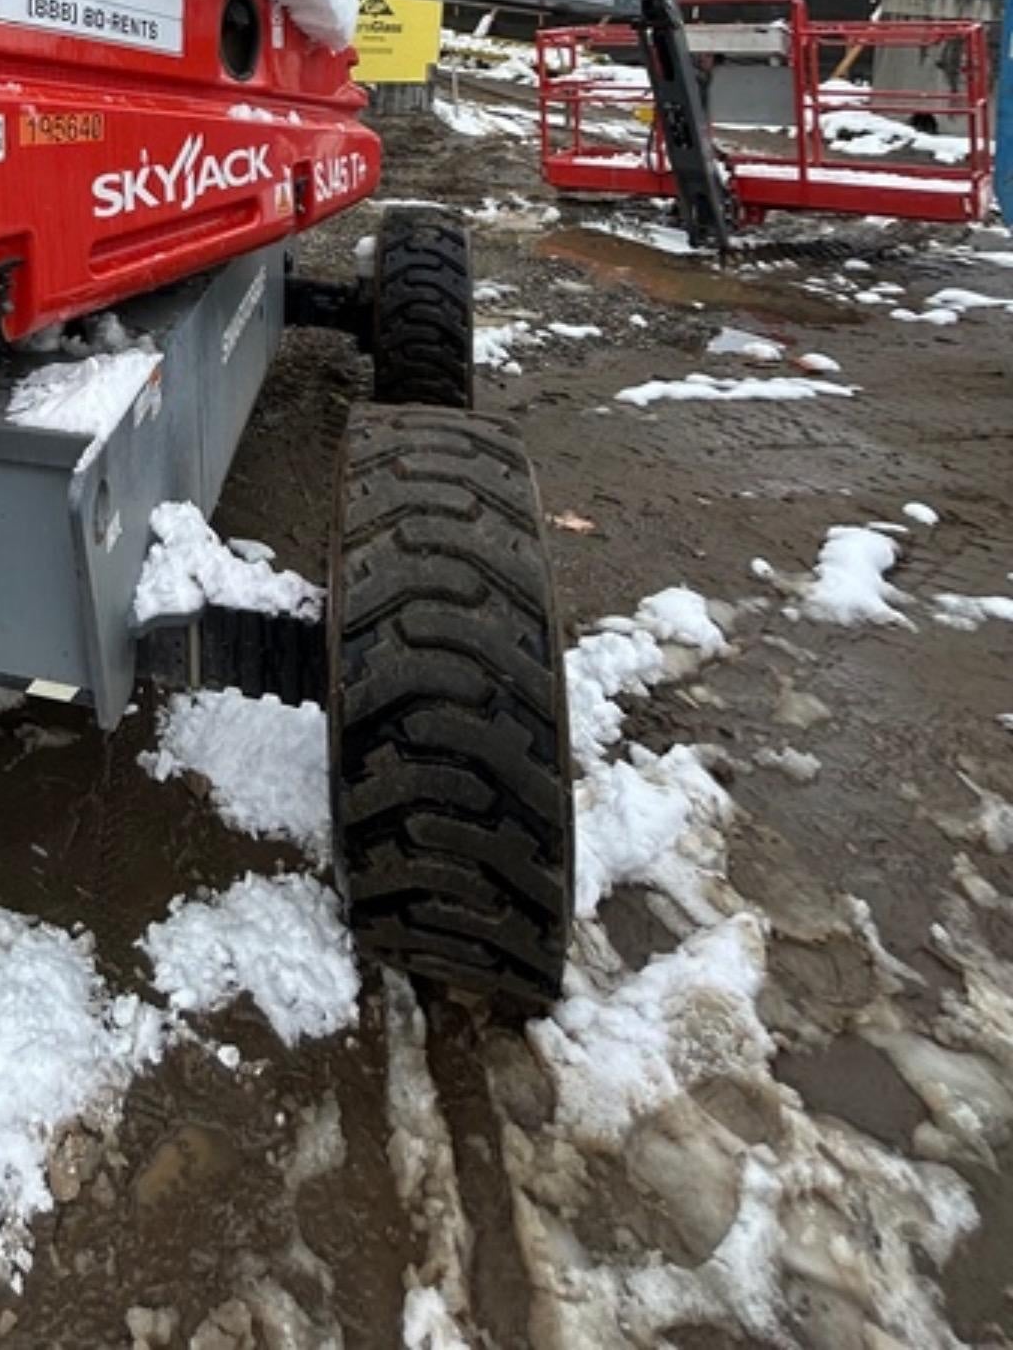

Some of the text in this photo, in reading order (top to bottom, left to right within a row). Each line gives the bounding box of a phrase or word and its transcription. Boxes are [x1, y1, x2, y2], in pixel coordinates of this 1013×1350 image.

[82, 4, 159, 40] 80-RENTS
[27, 113, 102, 143] 195640
[91, 132, 273, 218] SKYJACK
